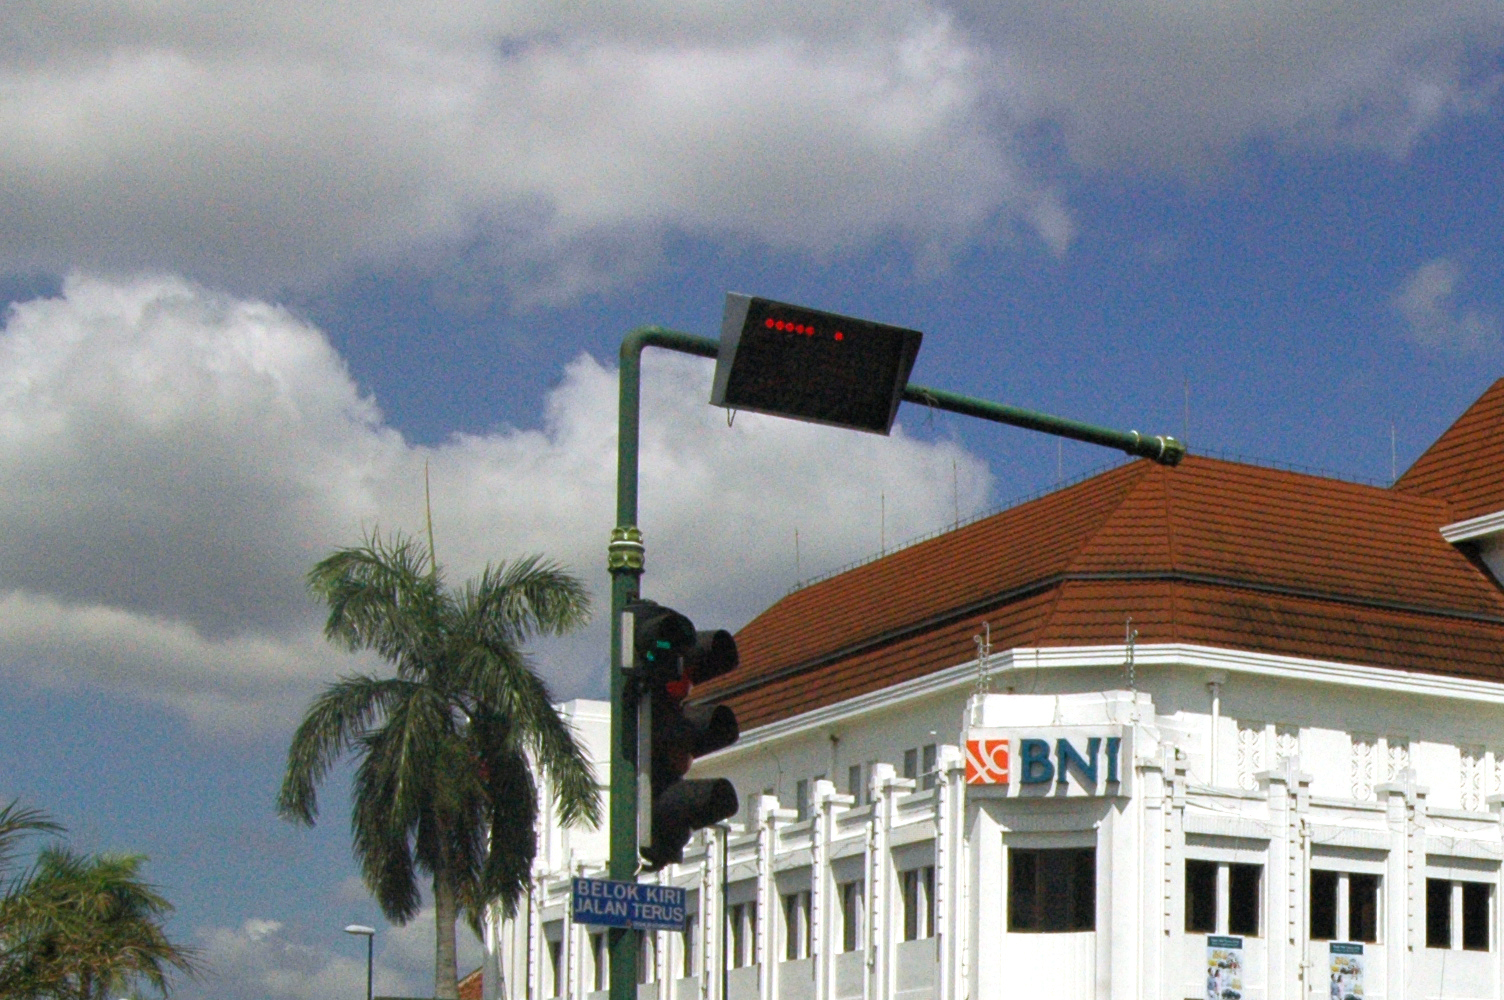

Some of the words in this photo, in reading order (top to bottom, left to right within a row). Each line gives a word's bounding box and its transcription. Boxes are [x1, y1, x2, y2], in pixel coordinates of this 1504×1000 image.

[1020, 737, 1122, 784] BNI
[578, 880, 639, 900] BELOK
[646, 887, 680, 904] KIRI
[575, 898, 627, 916] JALAN
[632, 903, 683, 922] TERUS
